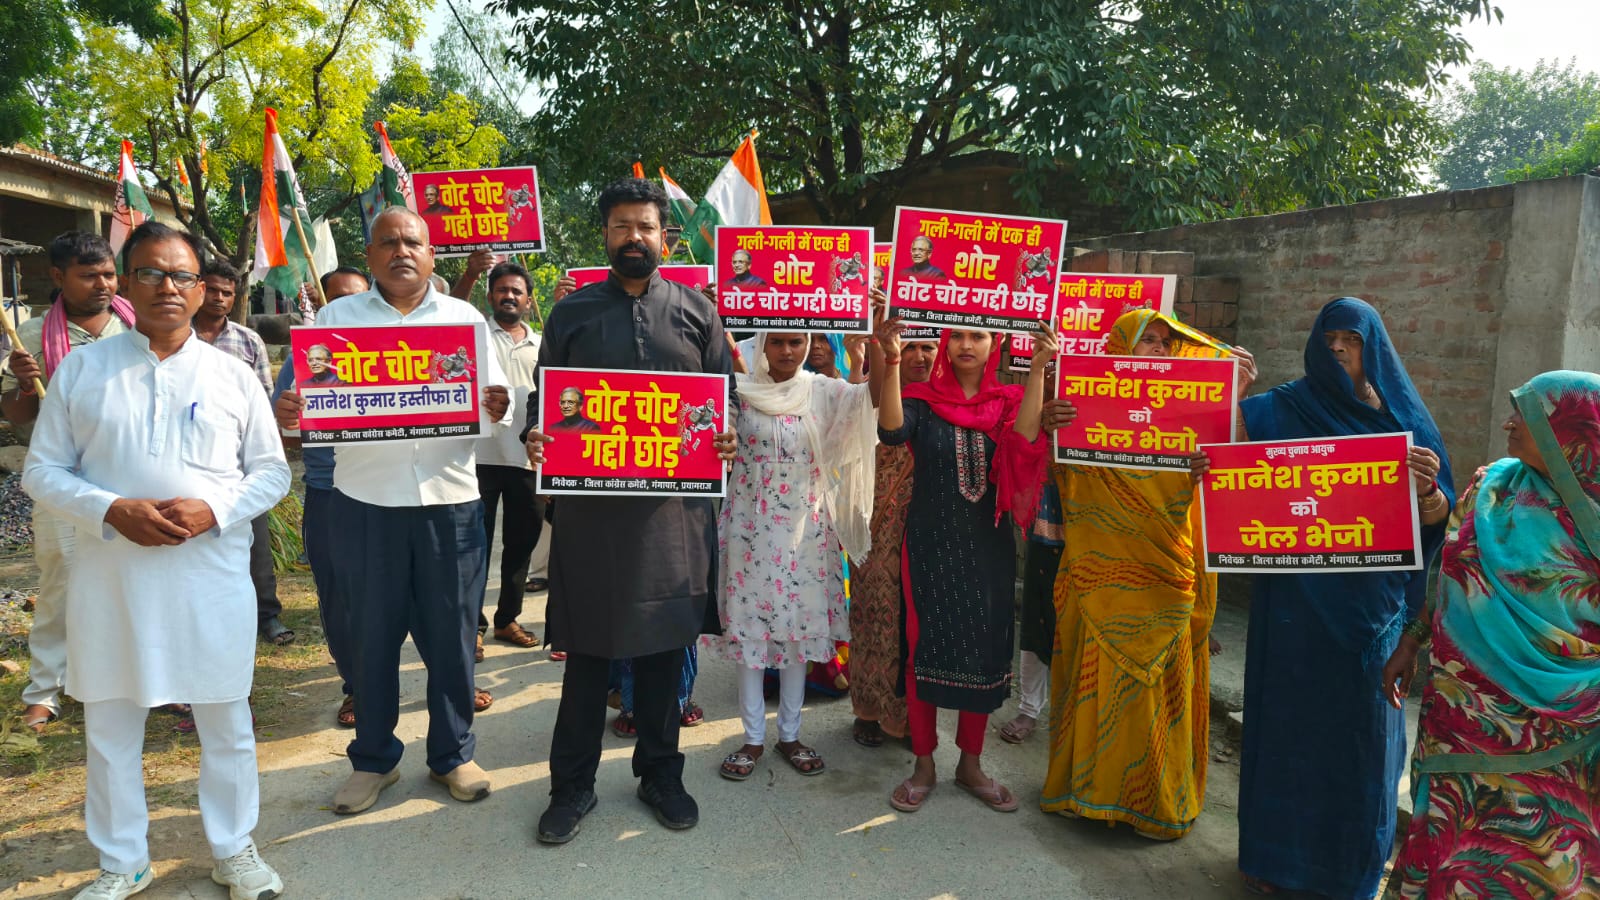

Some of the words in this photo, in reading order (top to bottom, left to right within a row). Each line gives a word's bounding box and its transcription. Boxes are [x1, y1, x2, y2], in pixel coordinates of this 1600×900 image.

[439, 177, 470, 207] वोट
[471, 175, 504, 205] चोर
[442, 207, 473, 238] गद्दी
[475, 206, 509, 241] छोड़
[919, 216, 983, 242] गली-गली
[985, 222, 1003, 243] में
[1001, 227, 1024, 245] एक
[1026, 225, 1042, 247] ही
[737, 231, 796, 251] गली-गली
[798, 232, 814, 251] में
[813, 236, 834, 252] एक
[836, 233, 850, 252] ही
[773, 253, 816, 286] शोर
[954, 244, 1001, 281] शोर
[722, 286, 756, 310] वोट
[758, 287, 791, 311] चोर
[793, 287, 827, 313] गद्दी
[898, 274, 933, 302] वोट
[935, 280, 970, 307] चोर
[972, 283, 1008, 311] गद्दी
[1089, 279, 1105, 298] में
[1104, 284, 1125, 298] एक
[1128, 280, 1143, 299] ही
[1062, 301, 1105, 331] शोर
[332, 341, 380, 384] वोट
[383, 340, 432, 382] चोर
[305, 390, 351, 411] ज्ञानेश
[353, 392, 396, 415] कुमार
[399, 385, 451, 409] इस्तीफा
[452, 384, 468, 404] दो
[585, 380, 630, 423] वोट
[634, 382, 680, 424] चोर
[1065, 371, 1142, 399] ज्ञानेश
[1146, 379, 1225, 408] कुमार
[1128, 407, 1153, 423] को
[341, 429, 361, 440] जिला
[1085, 422, 1135, 448] जेल
[1139, 426, 1198, 452] भेजो
[581, 425, 629, 470] गद्दी
[632, 426, 682, 477] छोड़
[1095, 450, 1112, 461] जिला
[1265, 447, 1286, 459] मुख्य
[1288, 445, 1309, 457] चुनाव
[1311, 444, 1336, 456] आयुक्त
[584, 478, 604, 488] जिला
[1209, 460, 1302, 491] ज्ञानेश
[1307, 460, 1400, 497] कुमार
[1289, 497, 1319, 516] को
[1239, 520, 1299, 549] जेल
[1305, 516, 1375, 548] भेजो
[1252, 554, 1273, 565] जिला
